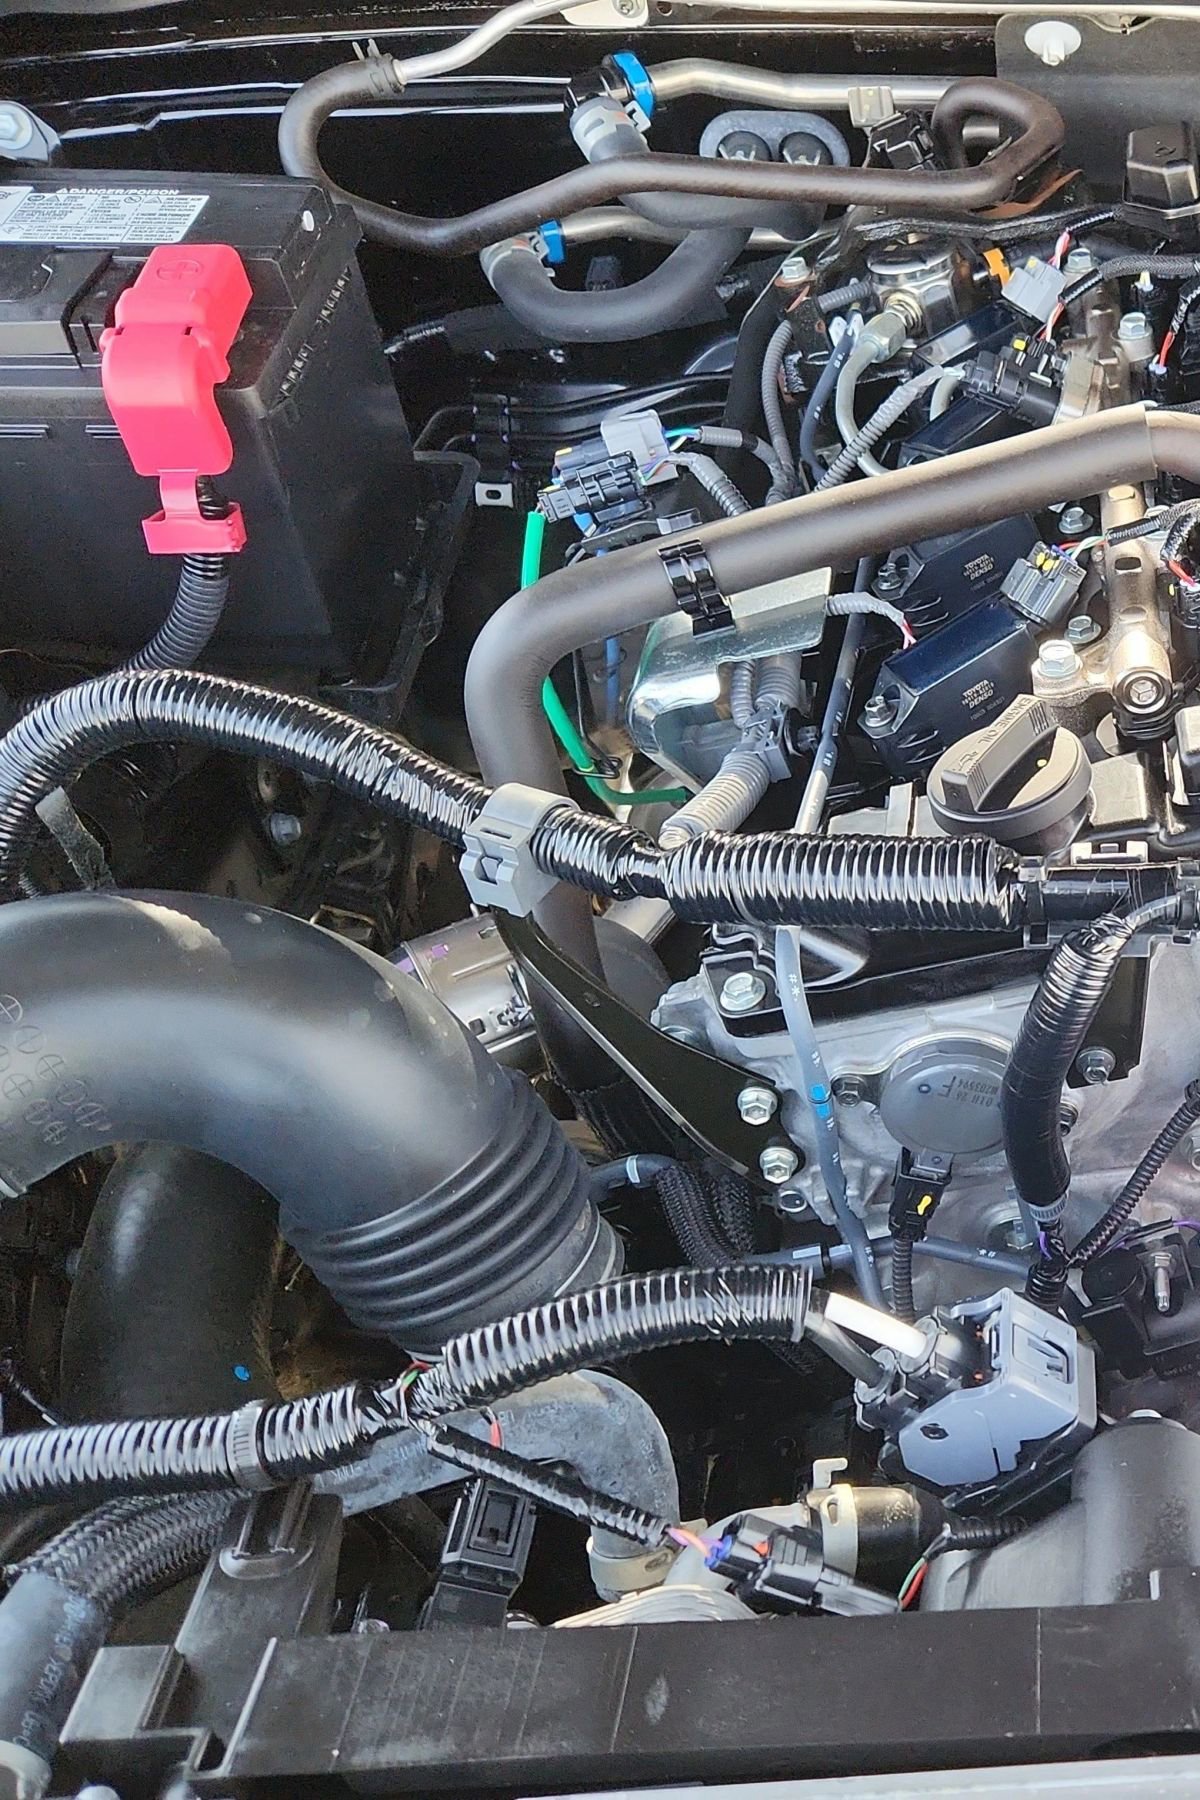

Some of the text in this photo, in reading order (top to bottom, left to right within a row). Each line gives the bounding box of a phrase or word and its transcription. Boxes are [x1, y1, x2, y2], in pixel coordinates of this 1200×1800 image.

[69, 187, 180, 196] DANGER/POISON
[962, 679, 989, 698] TOYOTA
[969, 688, 994, 709] DENSO
[994, 697, 1032, 729] ENGINE
[978, 728, 999, 744] OIL
